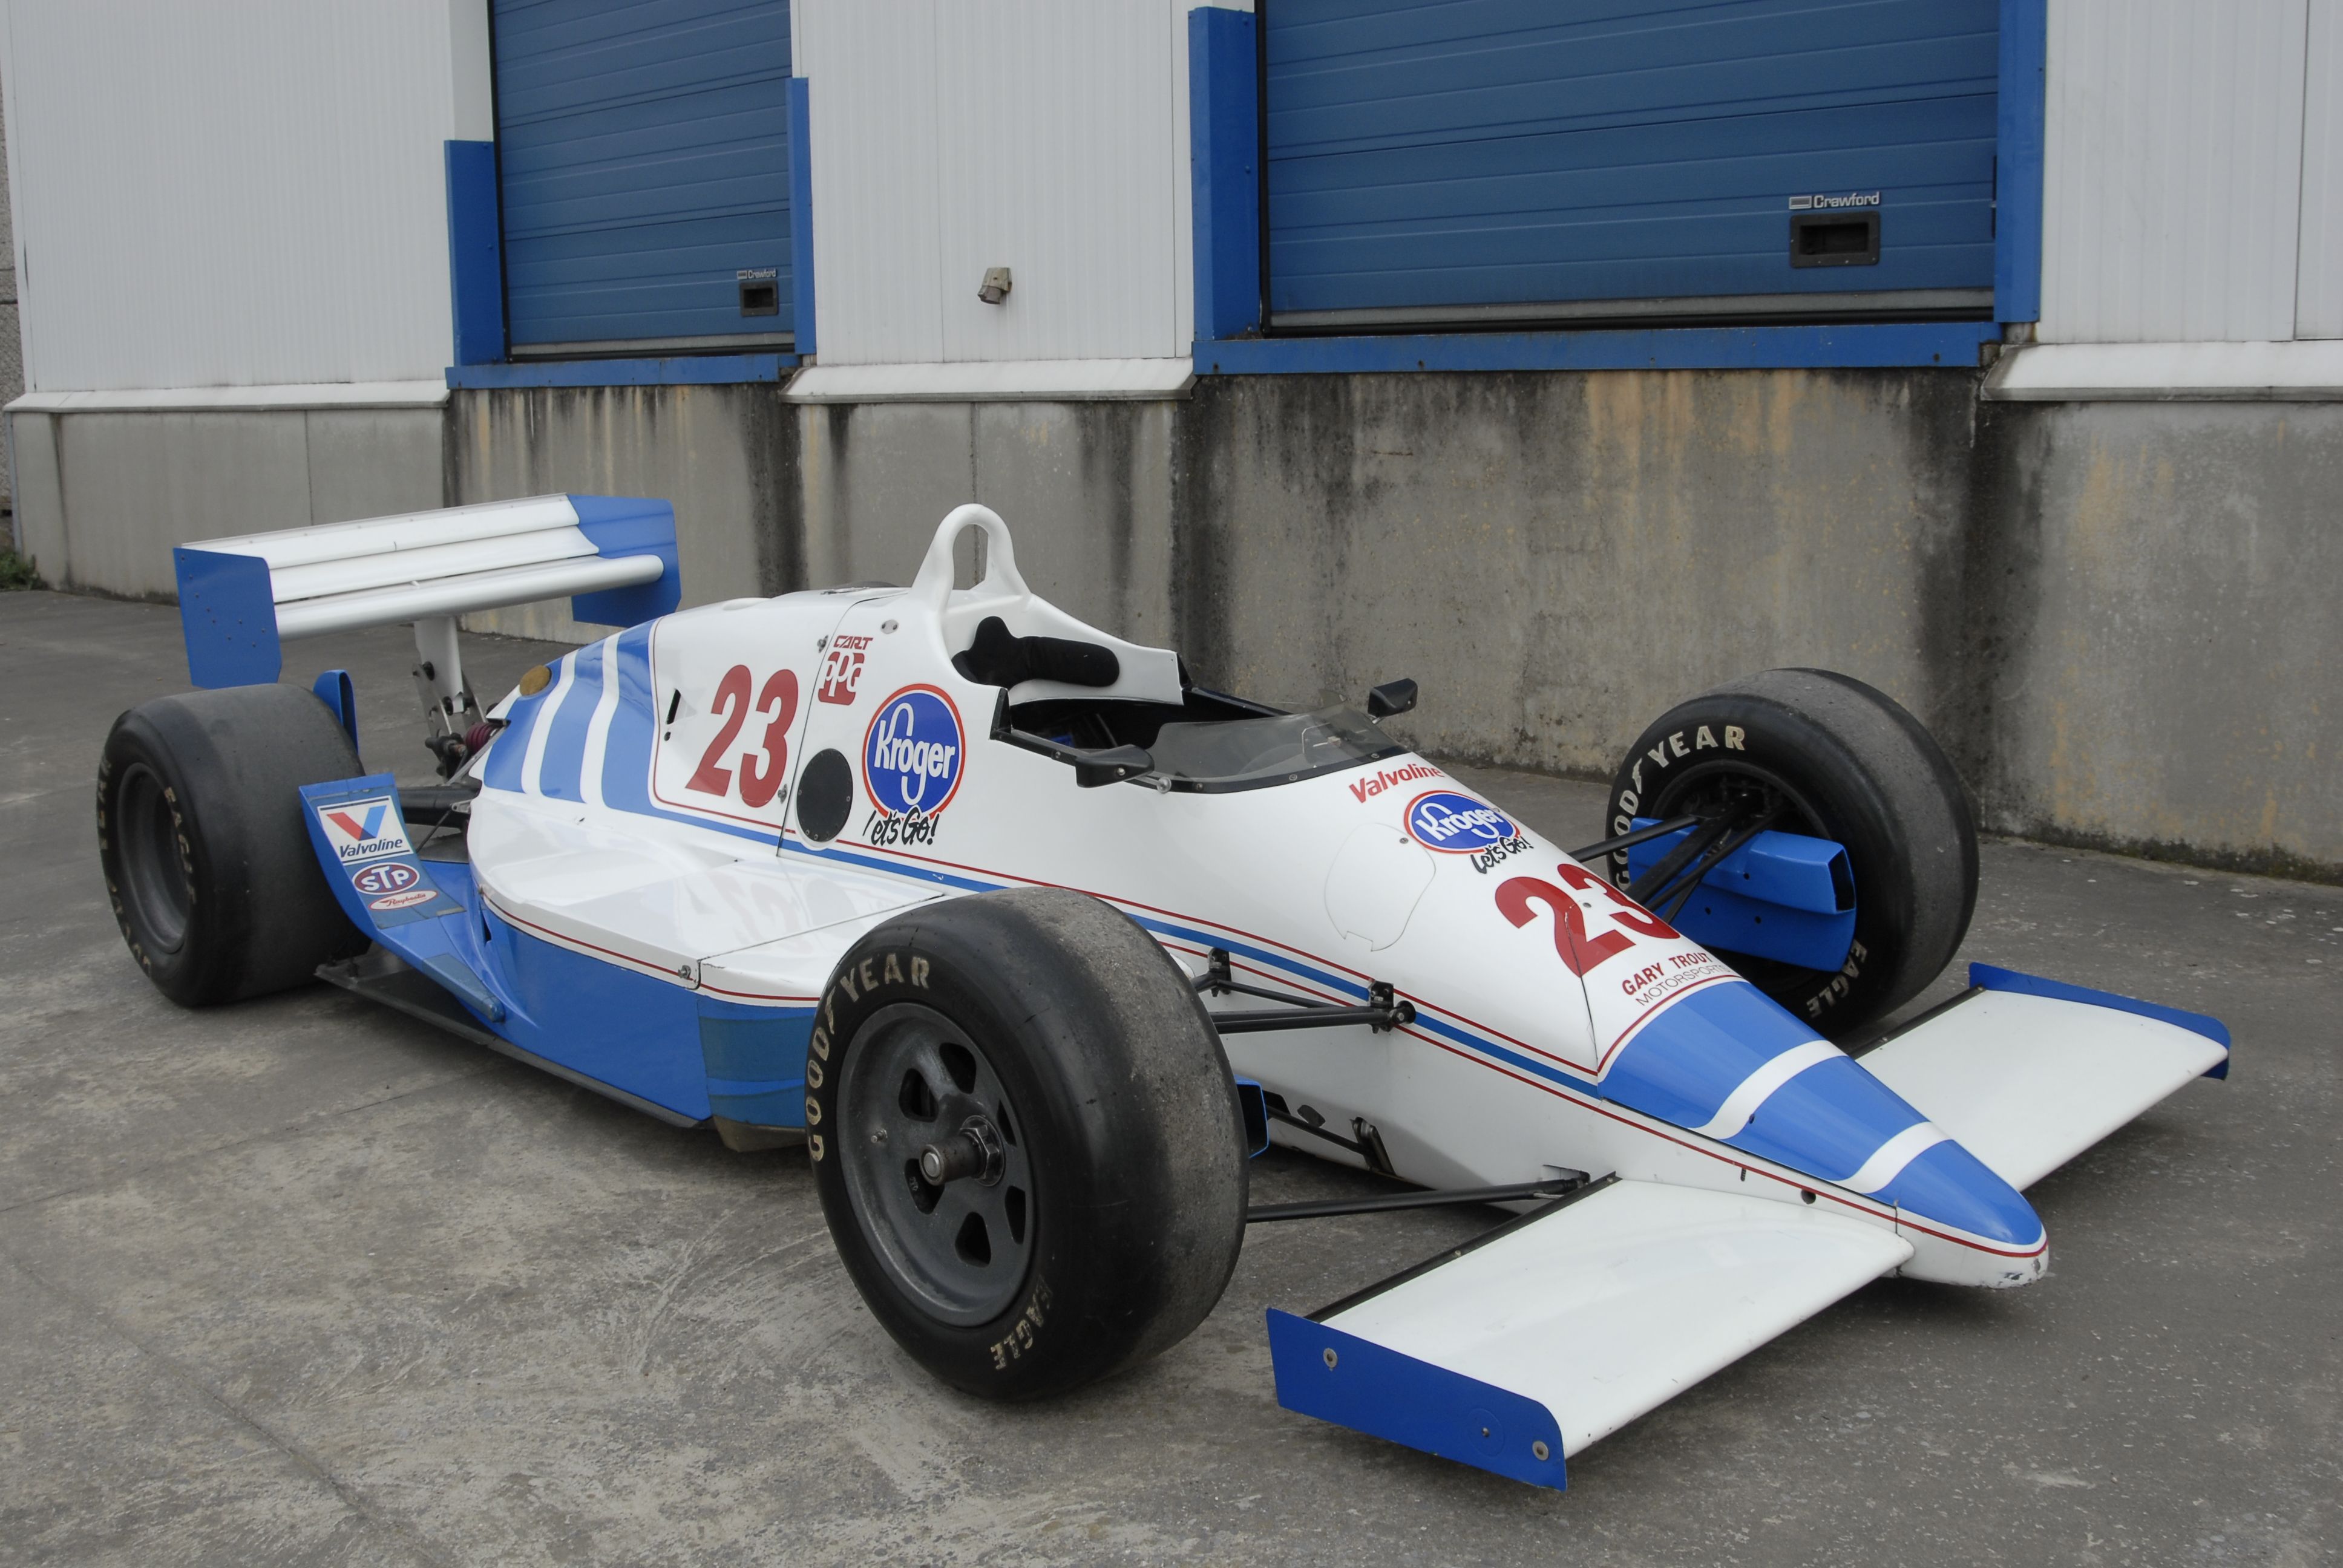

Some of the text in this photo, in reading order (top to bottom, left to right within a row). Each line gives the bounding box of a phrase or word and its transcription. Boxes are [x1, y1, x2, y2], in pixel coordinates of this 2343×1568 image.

[1814, 192, 1879, 208] Crawford
[833, 635, 874, 650] CART
[685, 665, 799, 808] 23
[874, 702, 956, 805] Kroger
[1349, 763, 1446, 804] Valvoline
[902, 806, 940, 846] Go!
[1415, 802, 1505, 841] Kroger
[339, 838, 402, 858] Valvoline
[1470, 835, 1534, 874] Let's Go!
[361, 866, 410, 892] STP
[1495, 863, 1680, 978] 23
[1622, 952, 1713, 996] GARY TROUT
[1636, 965, 1731, 1006] MOTORSPORTS
[1806, 939, 1868, 1019] EAGLE
